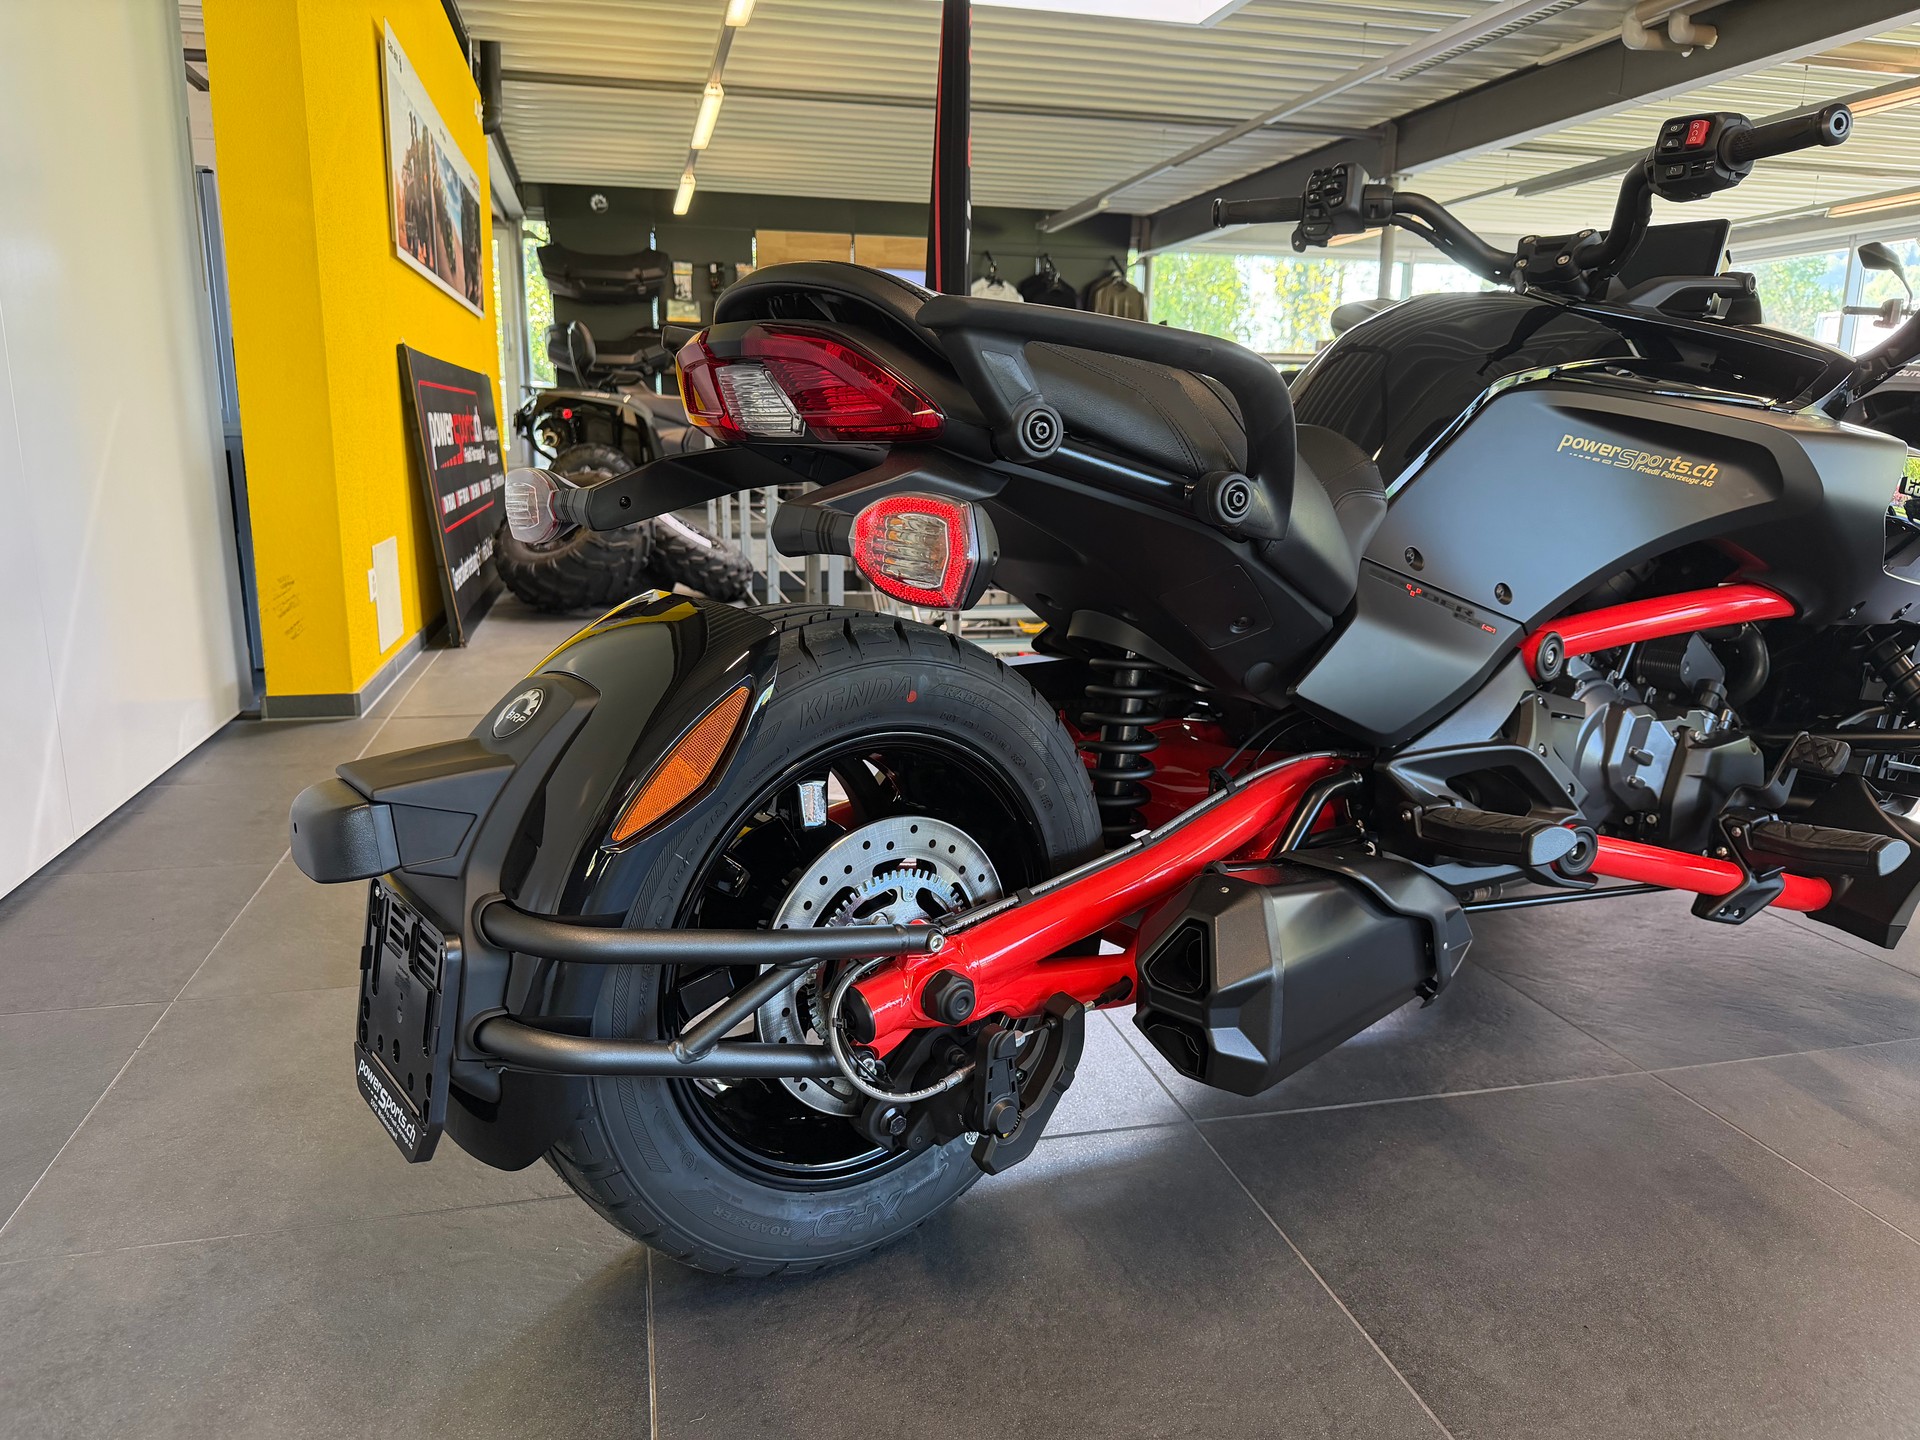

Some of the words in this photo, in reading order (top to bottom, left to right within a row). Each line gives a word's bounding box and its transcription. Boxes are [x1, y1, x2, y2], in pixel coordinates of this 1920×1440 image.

[1637, 465, 1661, 477] Friedli
[1661, 470, 1701, 486] Fahrzeuge
[1700, 479, 1715, 488] AG
[799, 676, 914, 731] KENDA
[944, 687, 992, 713] RADIAL
[505, 709, 527, 723] BRP
[712, 1205, 792, 1237] ROADSTER
